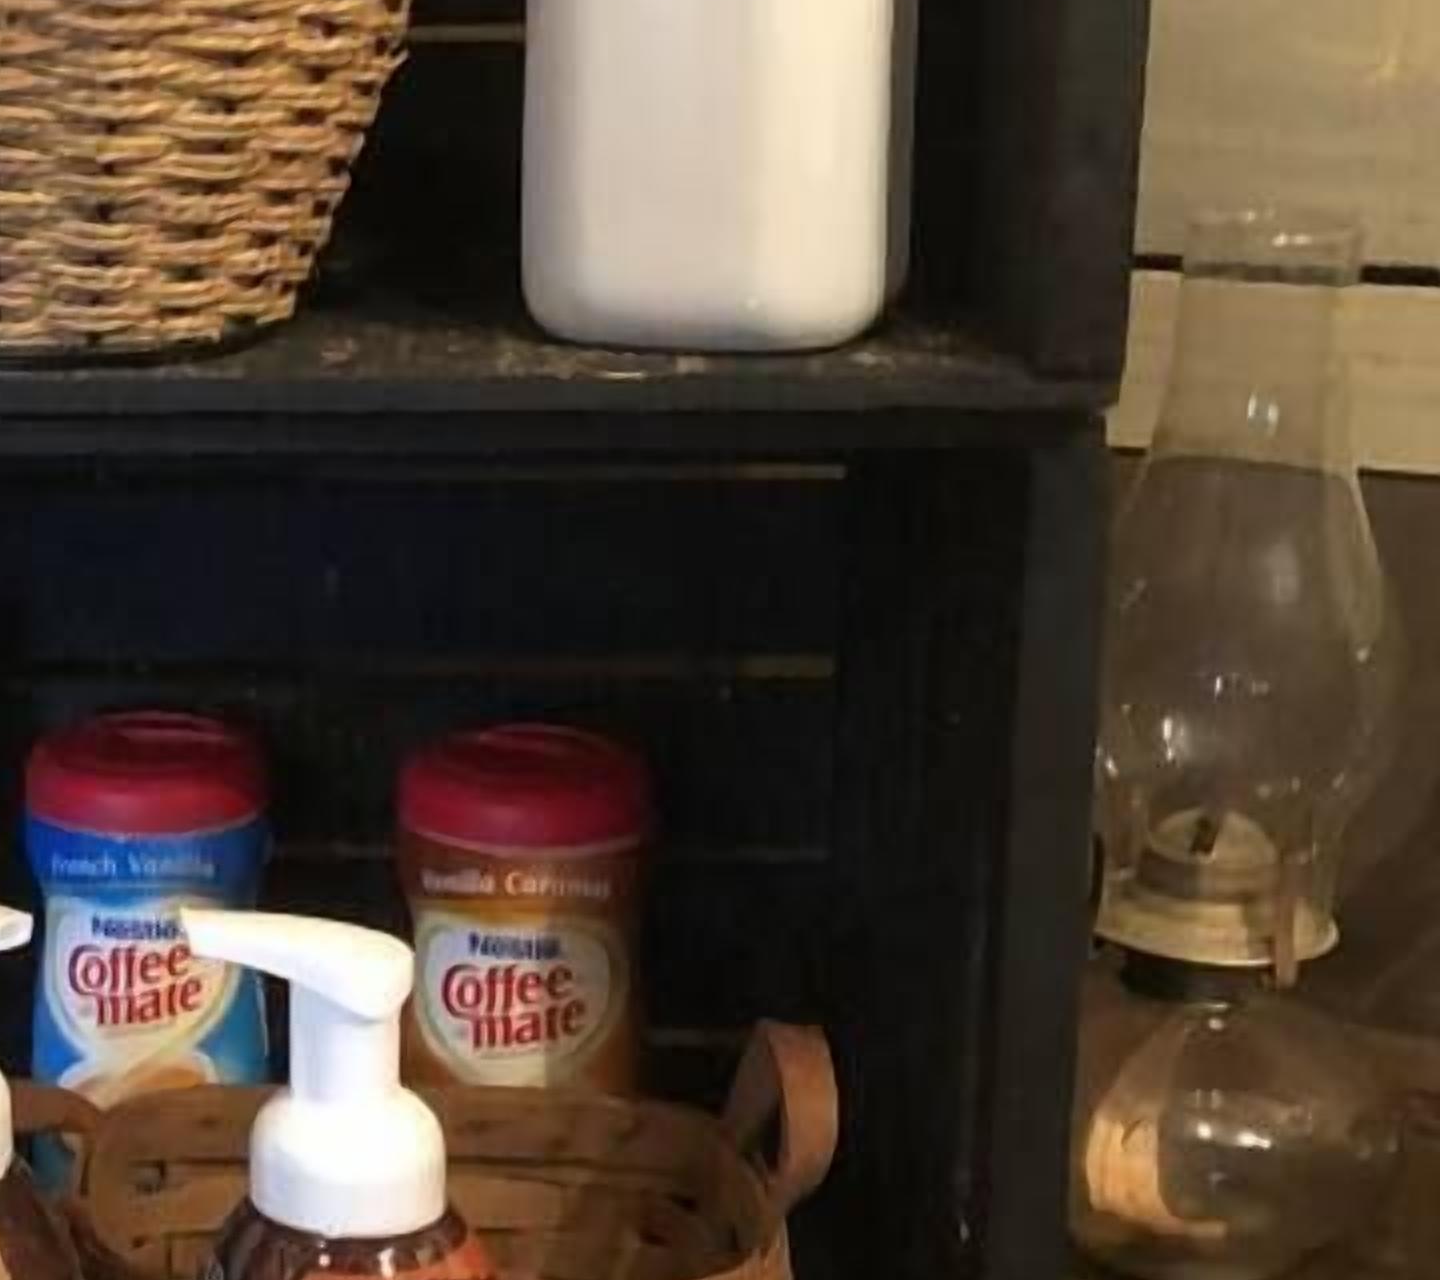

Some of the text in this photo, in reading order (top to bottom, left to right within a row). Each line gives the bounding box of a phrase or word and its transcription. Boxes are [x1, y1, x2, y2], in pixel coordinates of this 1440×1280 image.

[68, 942, 193, 997] Coffee
[441, 962, 574, 1019] Coffee
[97, 976, 203, 1026] mate
[470, 997, 587, 1049] mate
